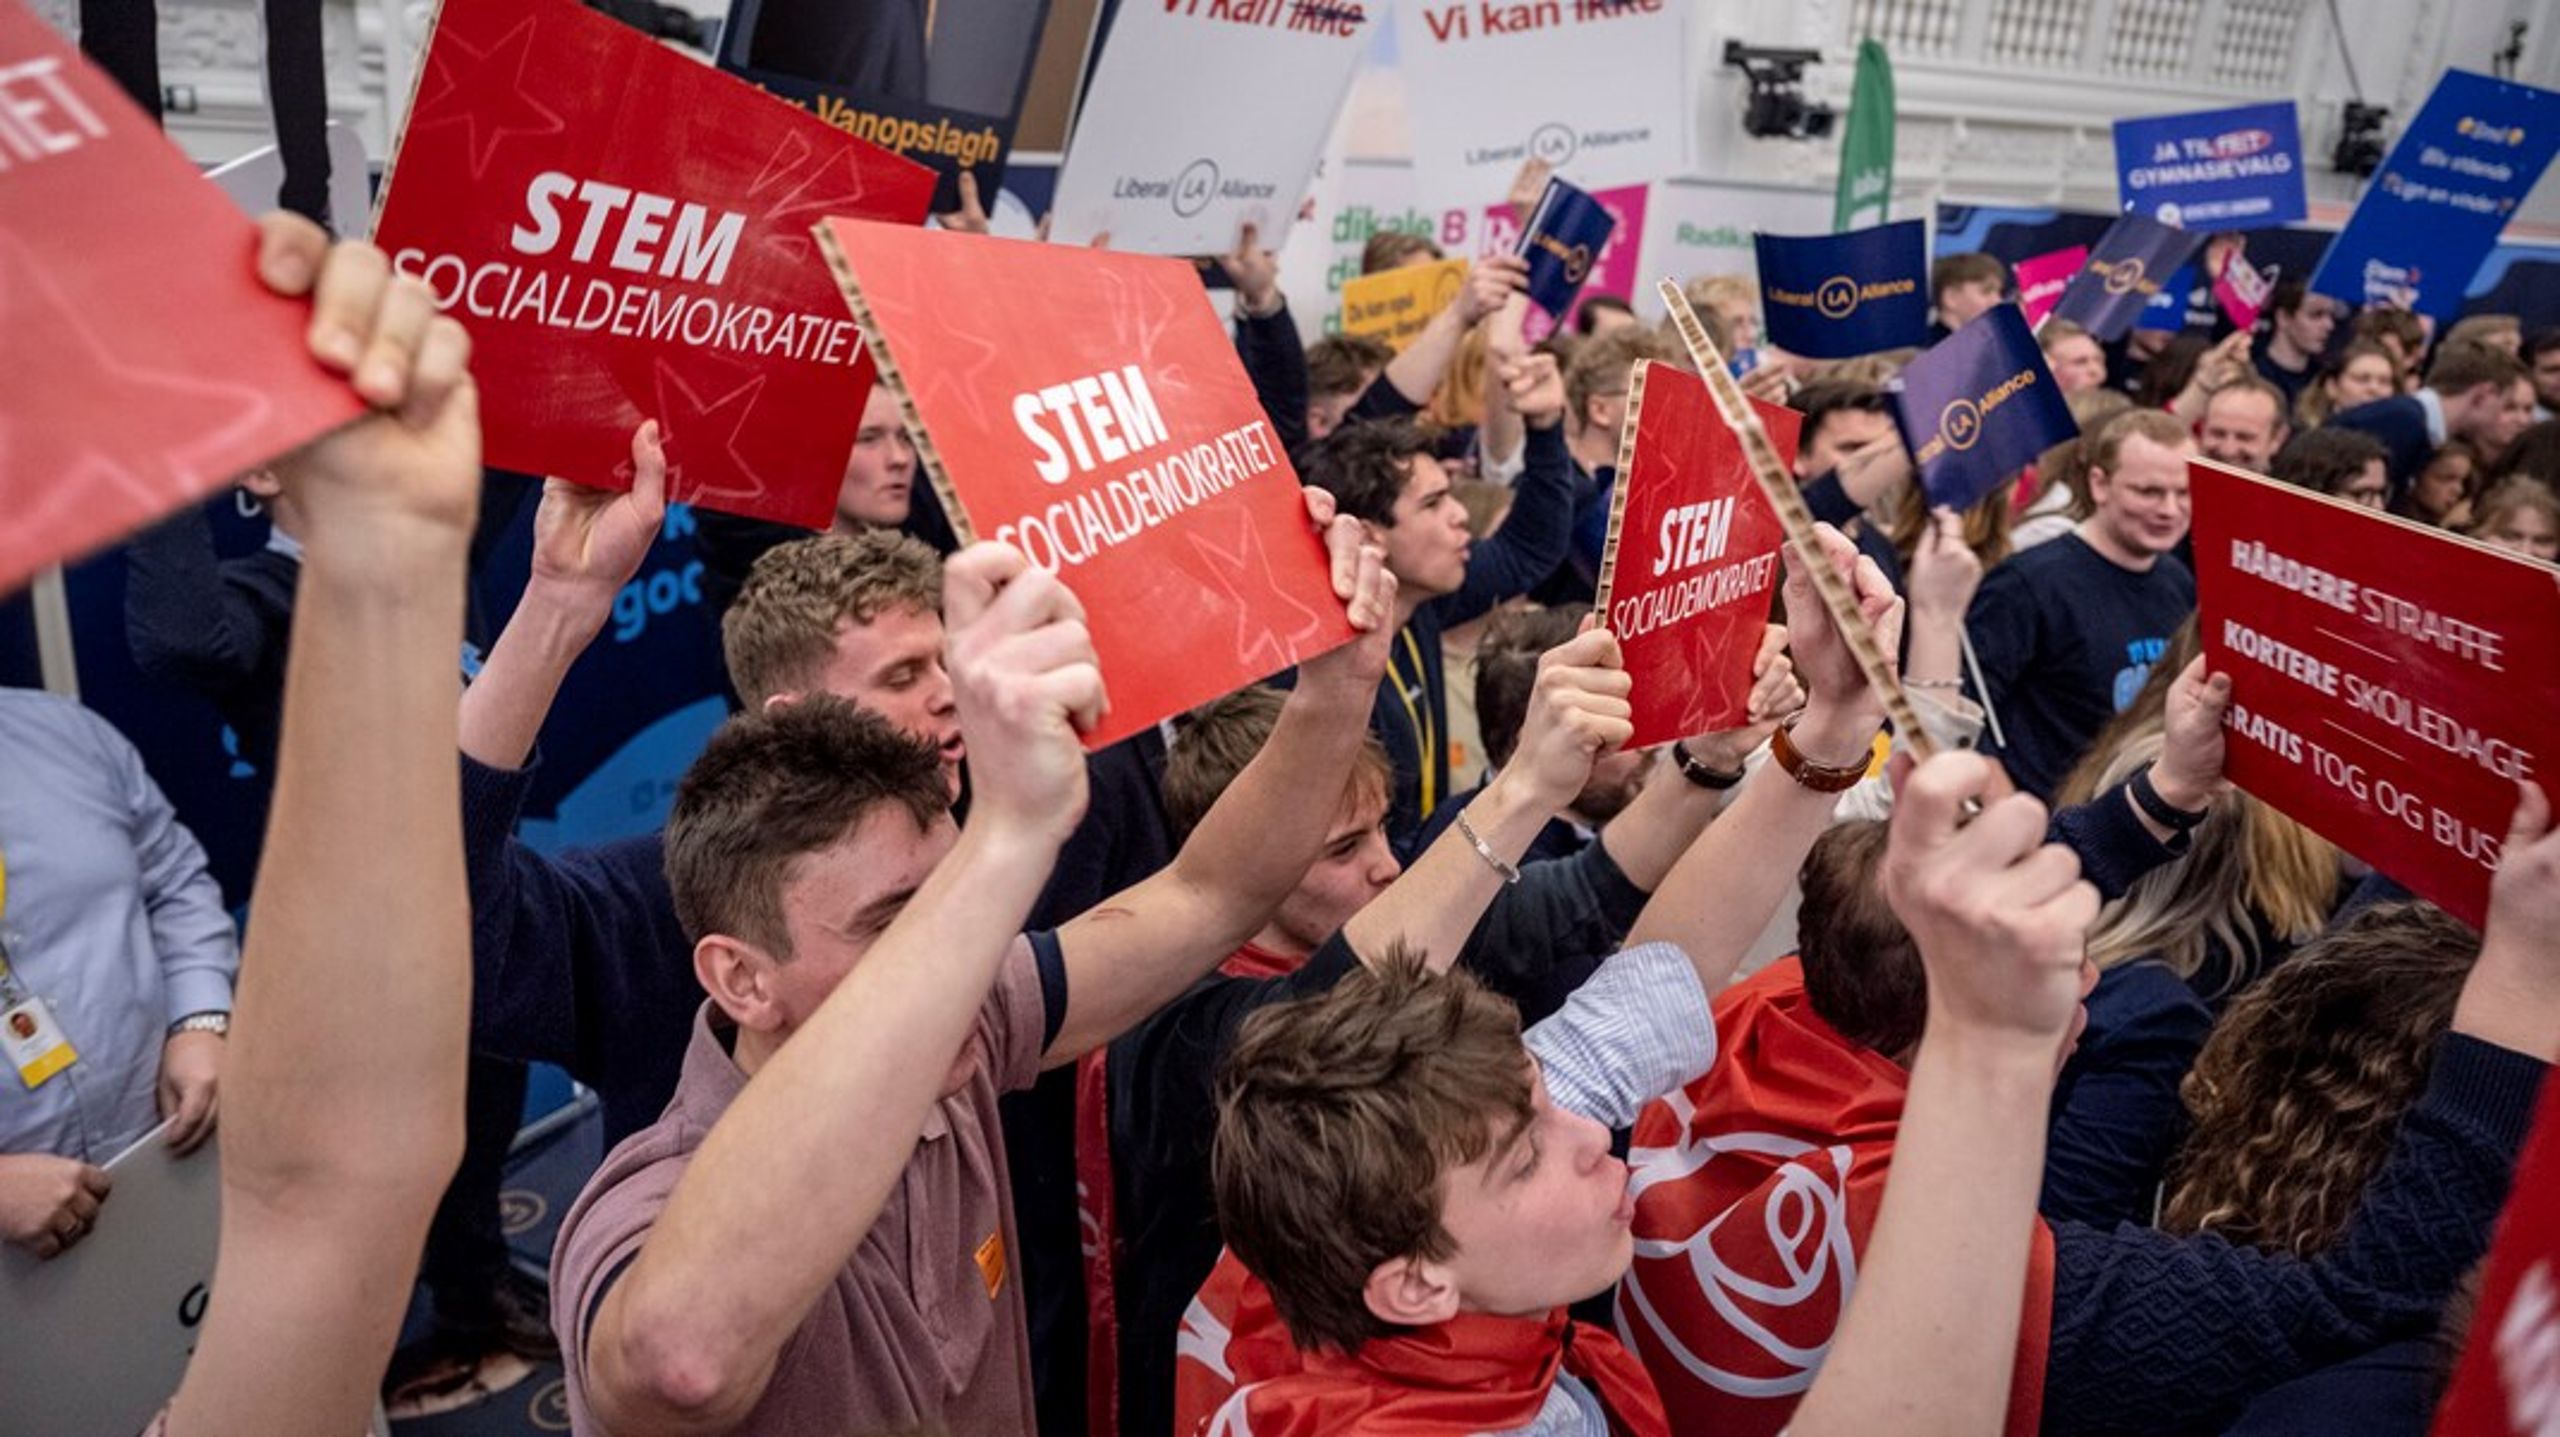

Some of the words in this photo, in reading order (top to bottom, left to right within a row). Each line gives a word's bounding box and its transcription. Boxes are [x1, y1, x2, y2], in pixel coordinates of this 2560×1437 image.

[1424, 5, 1469, 42] Vi
[1482, 0, 1561, 35] kan
[817, 94, 999, 168] Vanopslagh
[1465, 142, 1525, 167] Liberal
[1580, 127, 1651, 148] Alliance
[511, 171, 746, 286] STEM
[1113, 175, 1172, 199] Liberal
[1219, 175, 1277, 198] Alliance
[393, 247, 867, 367] SOCIALDEMOKRATIET
[1768, 286, 1814, 307] Liberal
[1860, 278, 1916, 301] Alliance
[1012, 364, 1169, 485] STEM
[1979, 369, 2037, 417] Alliance
[1653, 495, 1736, 577] STEM
[1614, 551, 1777, 641] SOCIALDEMOKRATIET
[2231, 537, 2358, 614] HÅRDERE
[2360, 587, 2505, 673] STRAFFE
[2224, 618, 2341, 698] KORTERE
[2345, 673, 2535, 782] SKOLEDAGE
[2308, 741, 2369, 801] TOG
[2375, 779, 2425, 832] OG
[2432, 807, 2502, 873] BUS
